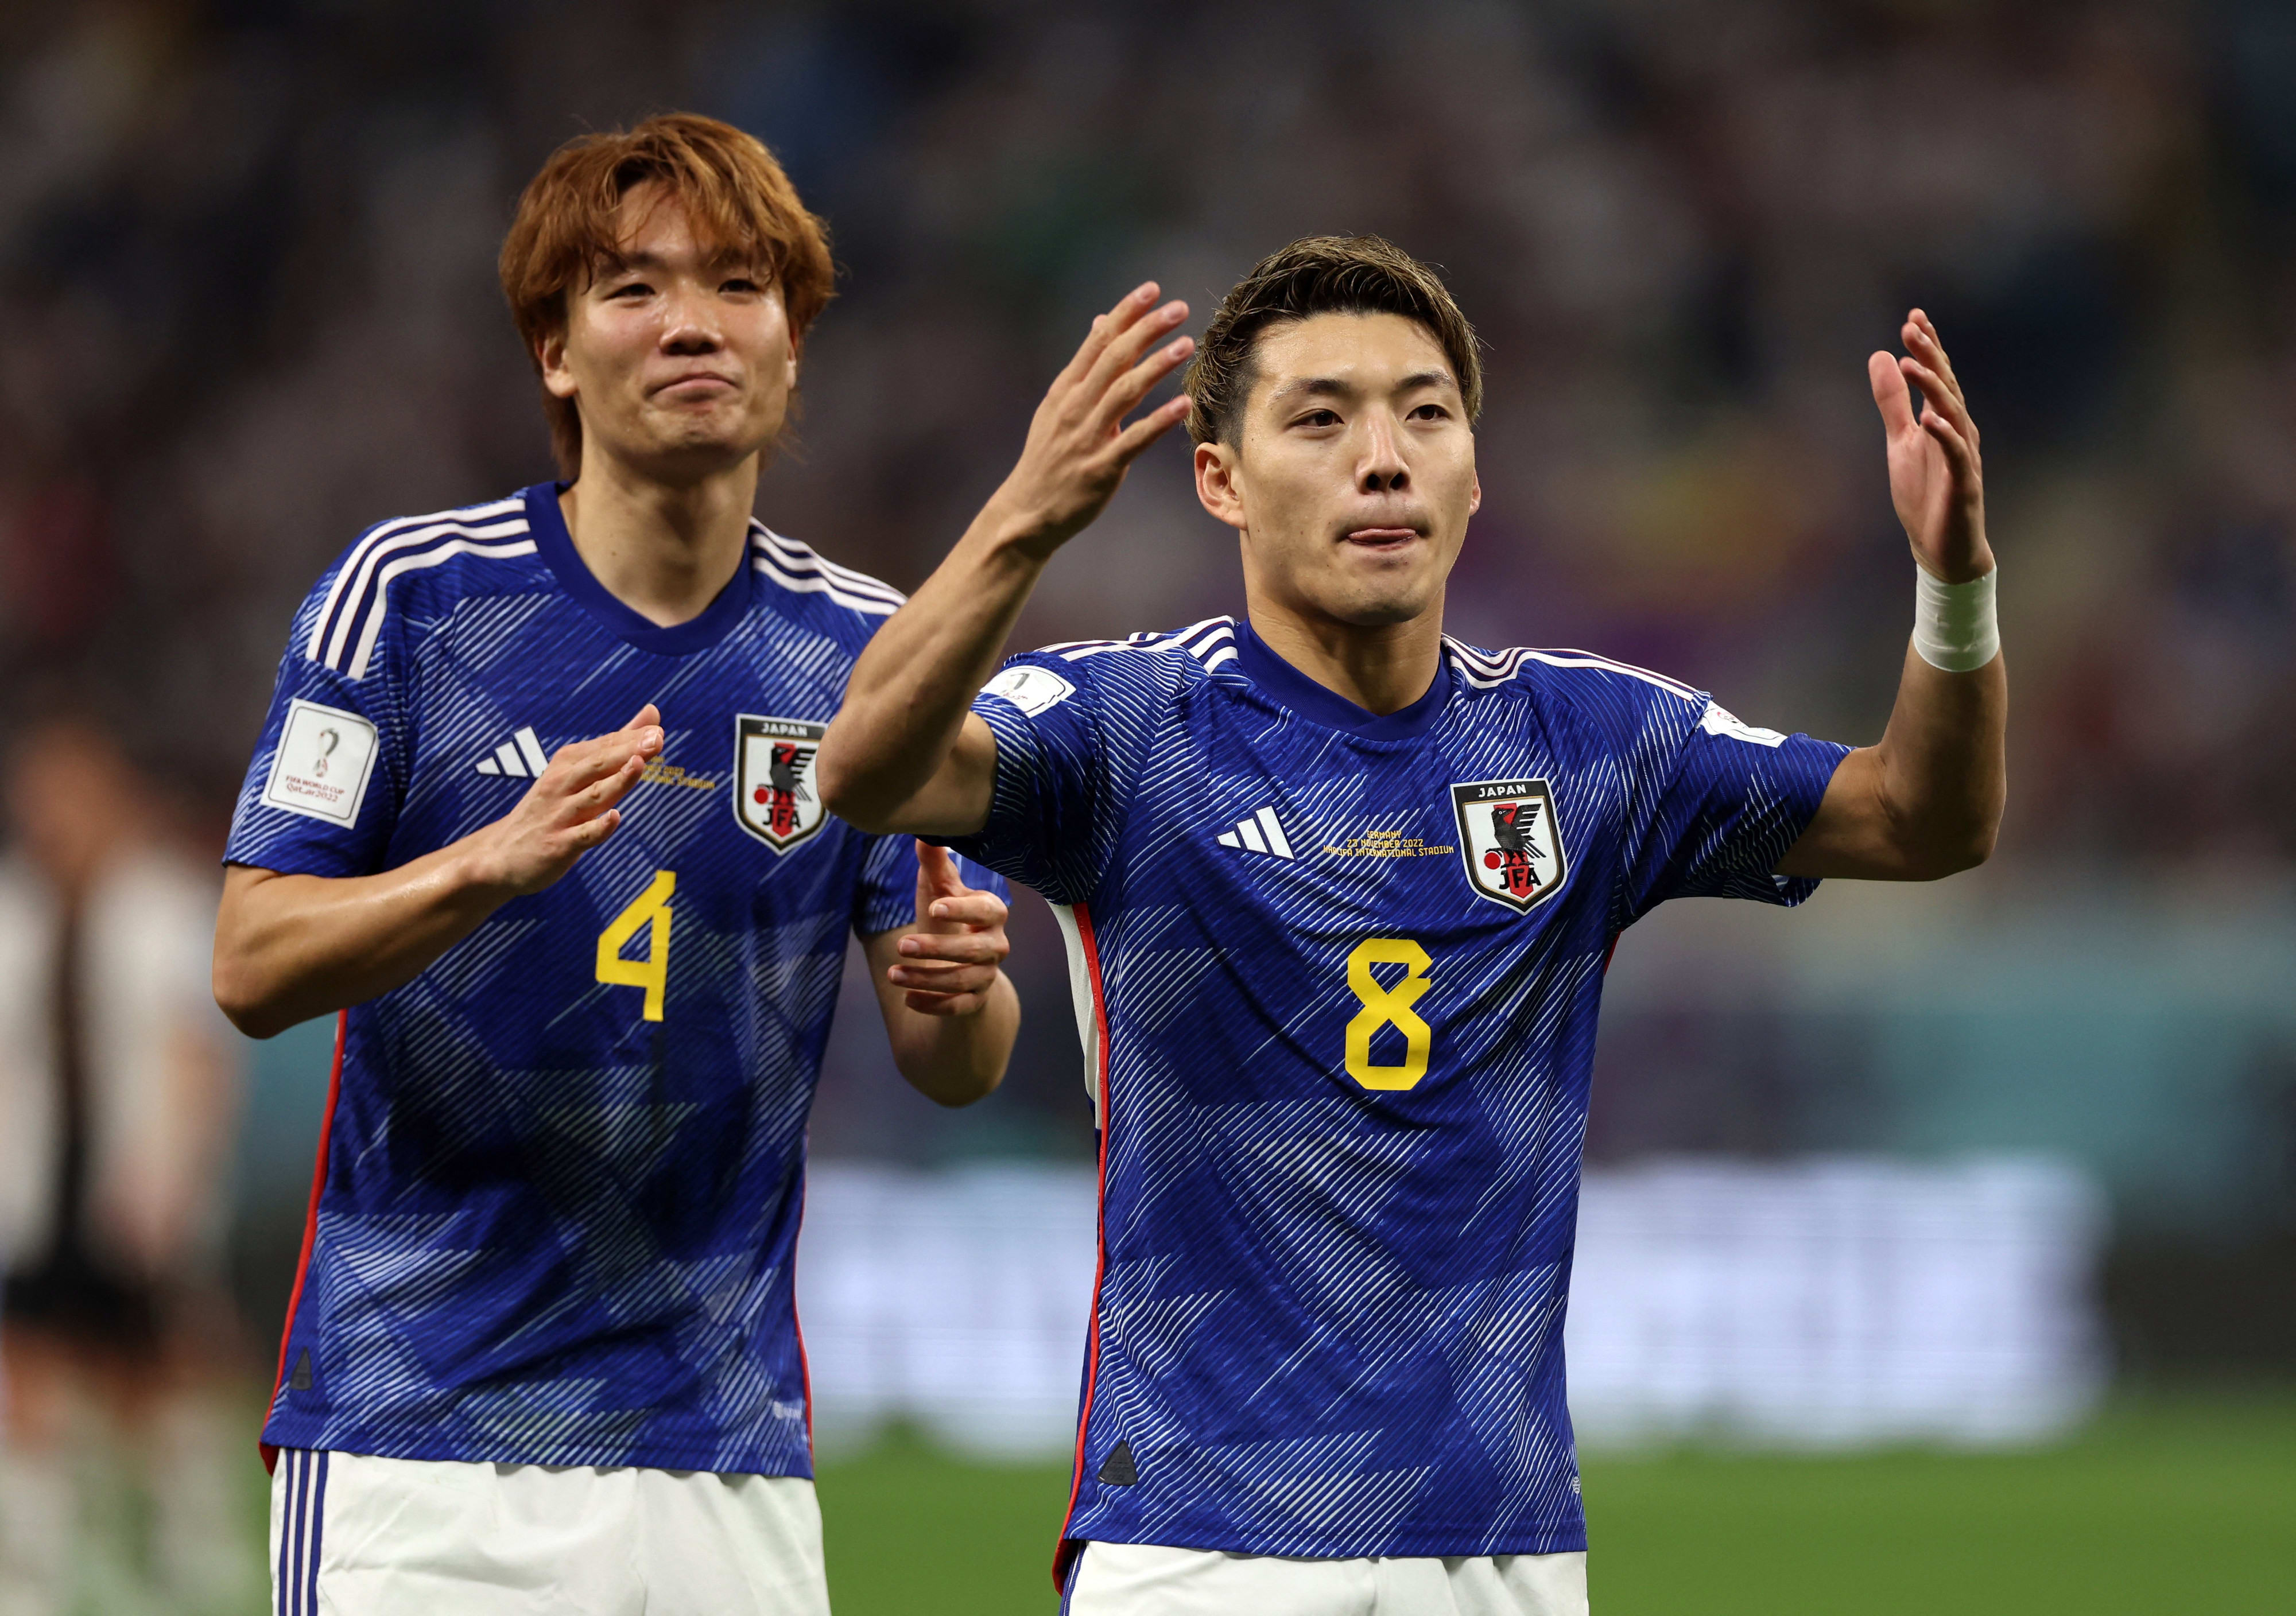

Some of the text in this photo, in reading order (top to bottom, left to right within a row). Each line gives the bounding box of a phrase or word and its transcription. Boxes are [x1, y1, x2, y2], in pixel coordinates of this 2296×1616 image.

[762, 722, 808, 737] JAPAN
[286, 775, 344, 794] FIFA WORLD CUP
[1478, 784, 1527, 798] JAPAN
[315, 791, 338, 802] 2022
[762, 807, 801, 828] JFA
[1367, 830, 1402, 839] GERMANY
[1347, 839, 1424, 848] 23 NOVEMBER 2022
[1323, 845, 1454, 858] KHALIFA INTERNATIONAL STADIUM
[1499, 867, 1542, 889] JFA
[595, 869, 676, 1021] 4
[1345, 938, 1433, 1090] 8
